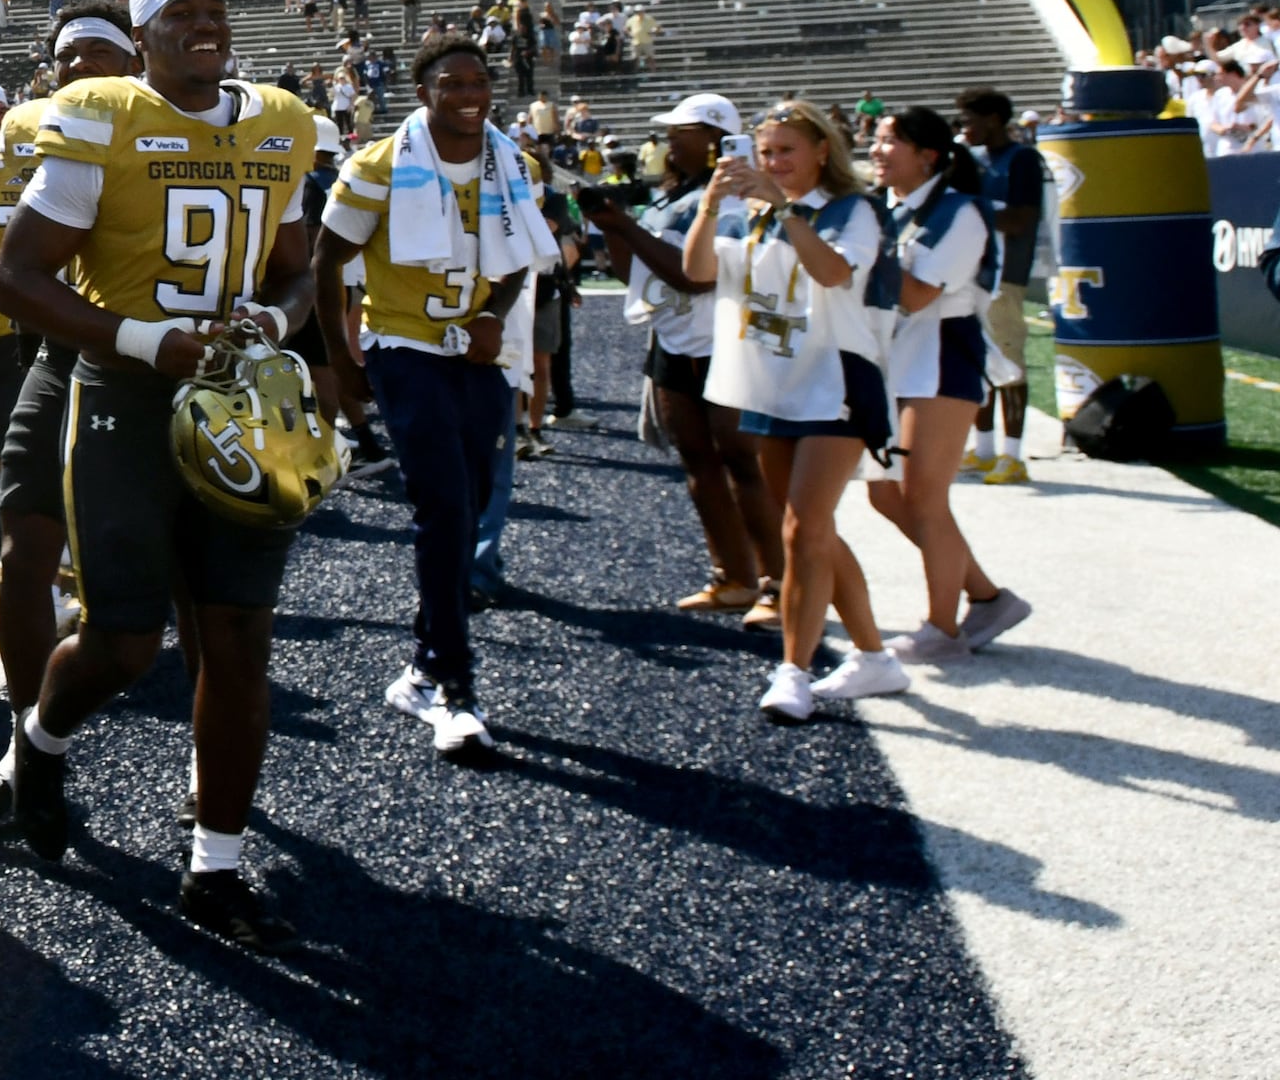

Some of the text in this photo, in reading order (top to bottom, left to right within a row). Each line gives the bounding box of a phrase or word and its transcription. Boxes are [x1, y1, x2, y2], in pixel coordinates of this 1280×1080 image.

[156, 141, 184, 150] Veritiv
[258, 137, 292, 150] ACC
[148, 161, 291, 182] GEORGIA TECH
[154, 184, 269, 319] 91
